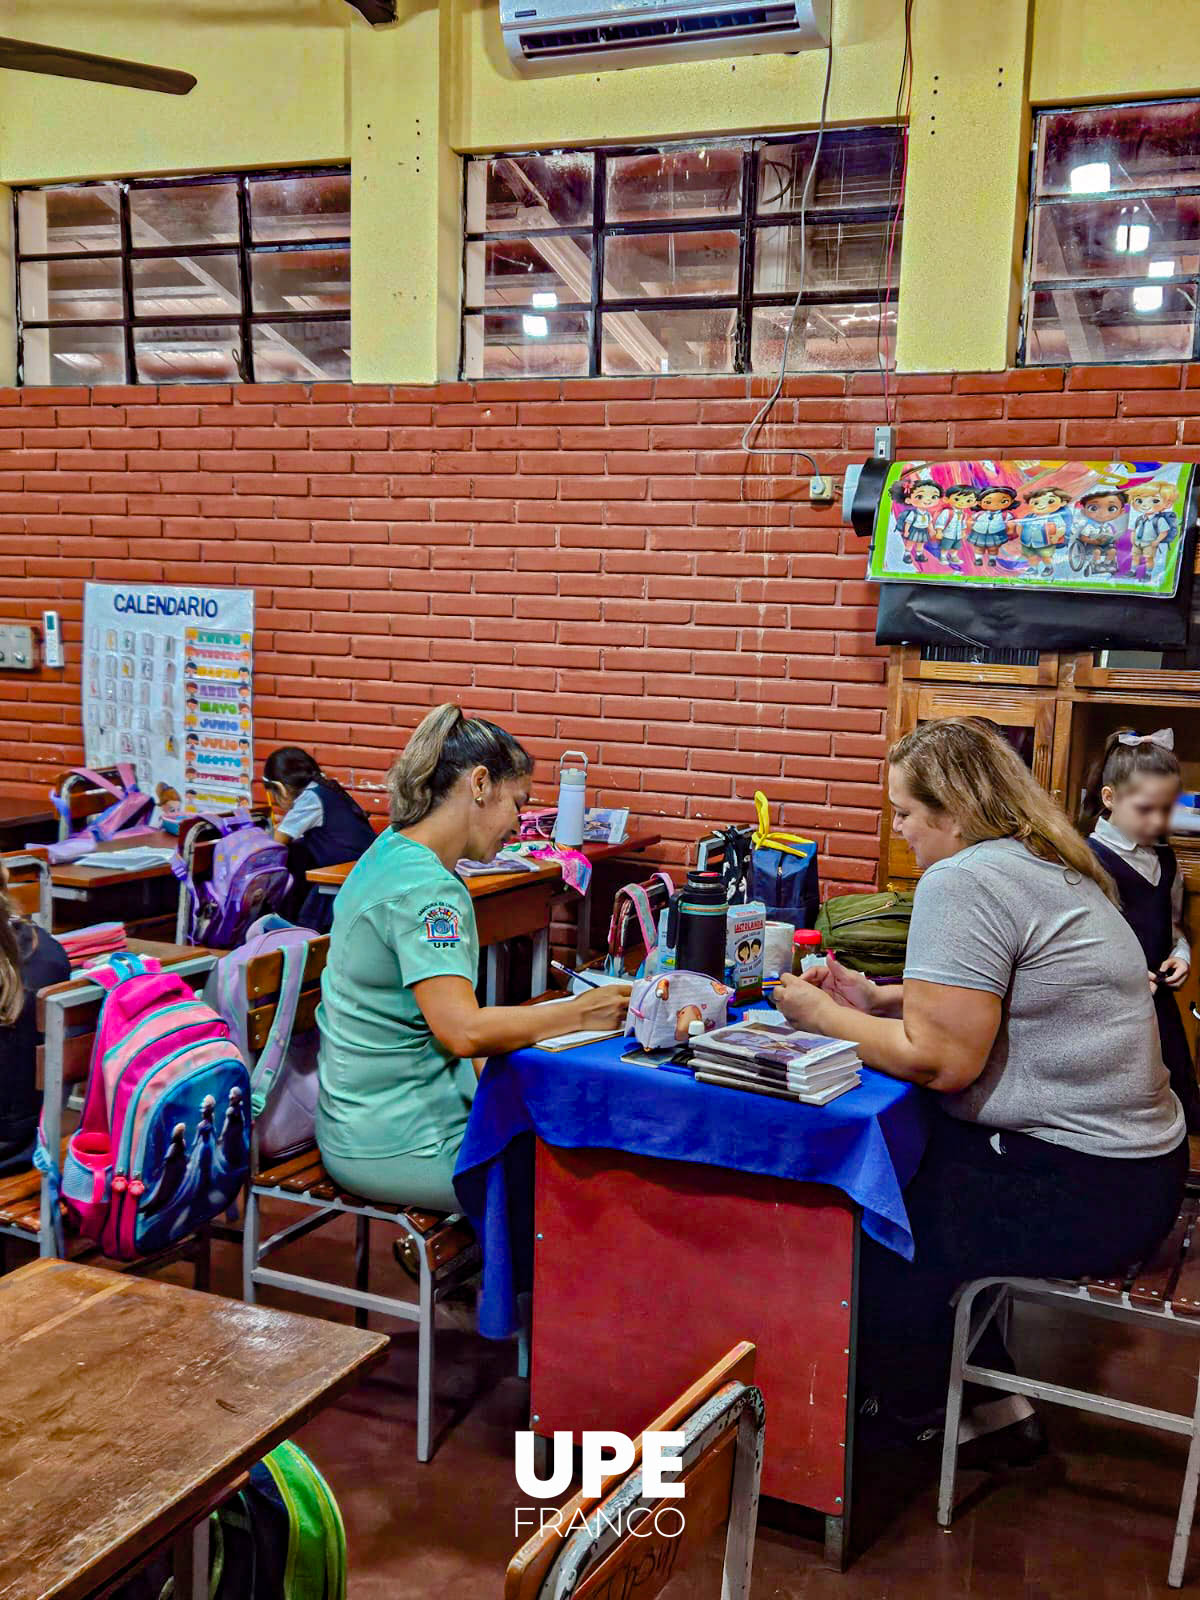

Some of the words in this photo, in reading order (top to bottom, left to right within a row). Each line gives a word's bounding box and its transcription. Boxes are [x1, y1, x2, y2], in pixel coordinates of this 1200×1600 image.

[113, 593, 218, 618] CALENDARIO
[200, 701, 238, 714] MAYO
[200, 736, 239, 751] JULIO
